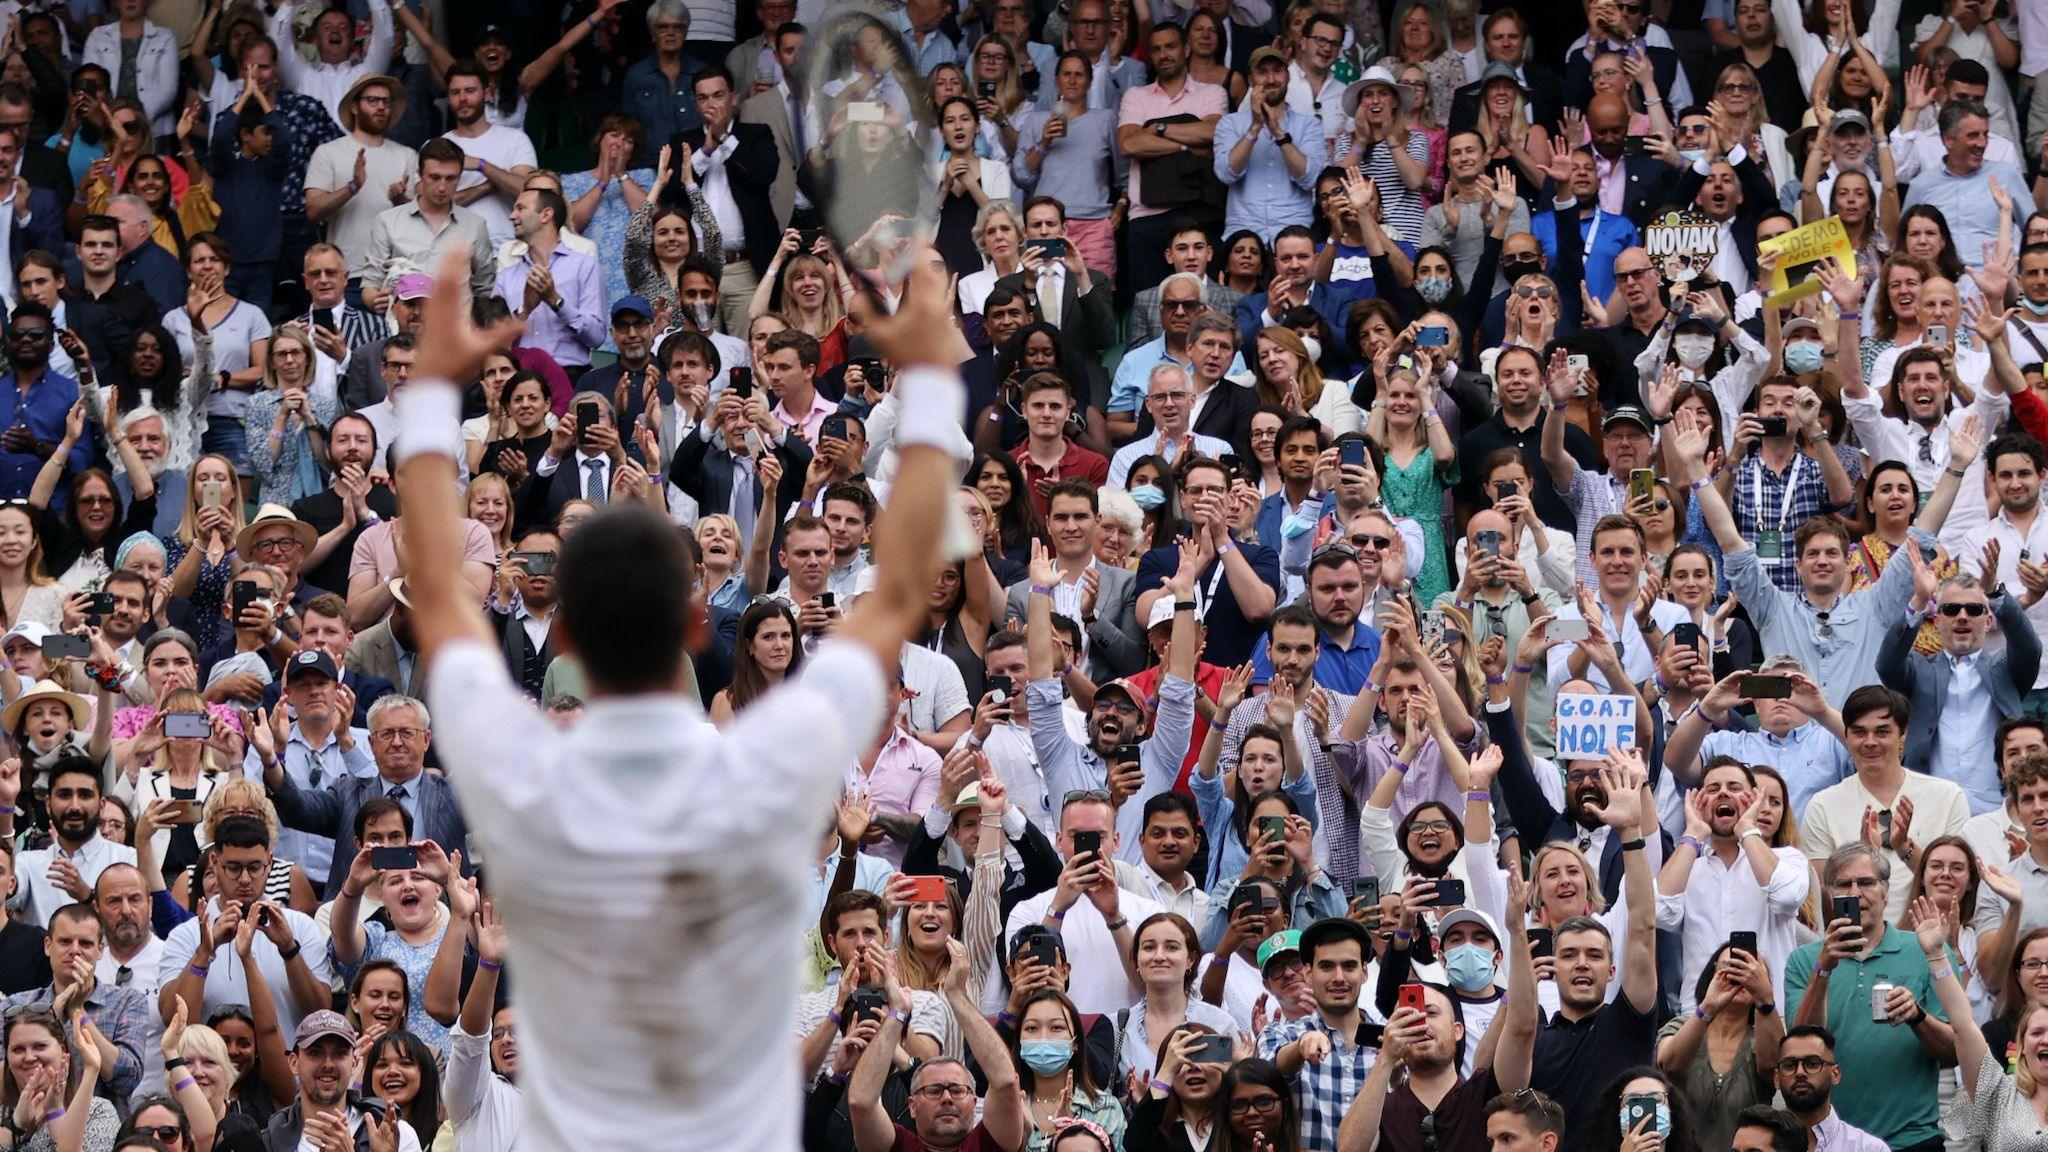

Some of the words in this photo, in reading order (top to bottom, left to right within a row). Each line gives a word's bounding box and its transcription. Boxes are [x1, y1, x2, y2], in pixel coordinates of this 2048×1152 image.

[1646, 226, 1717, 255] NOVAK
[1788, 242, 1831, 262] NOLE
[1559, 699, 1634, 717] G.O.A.T
